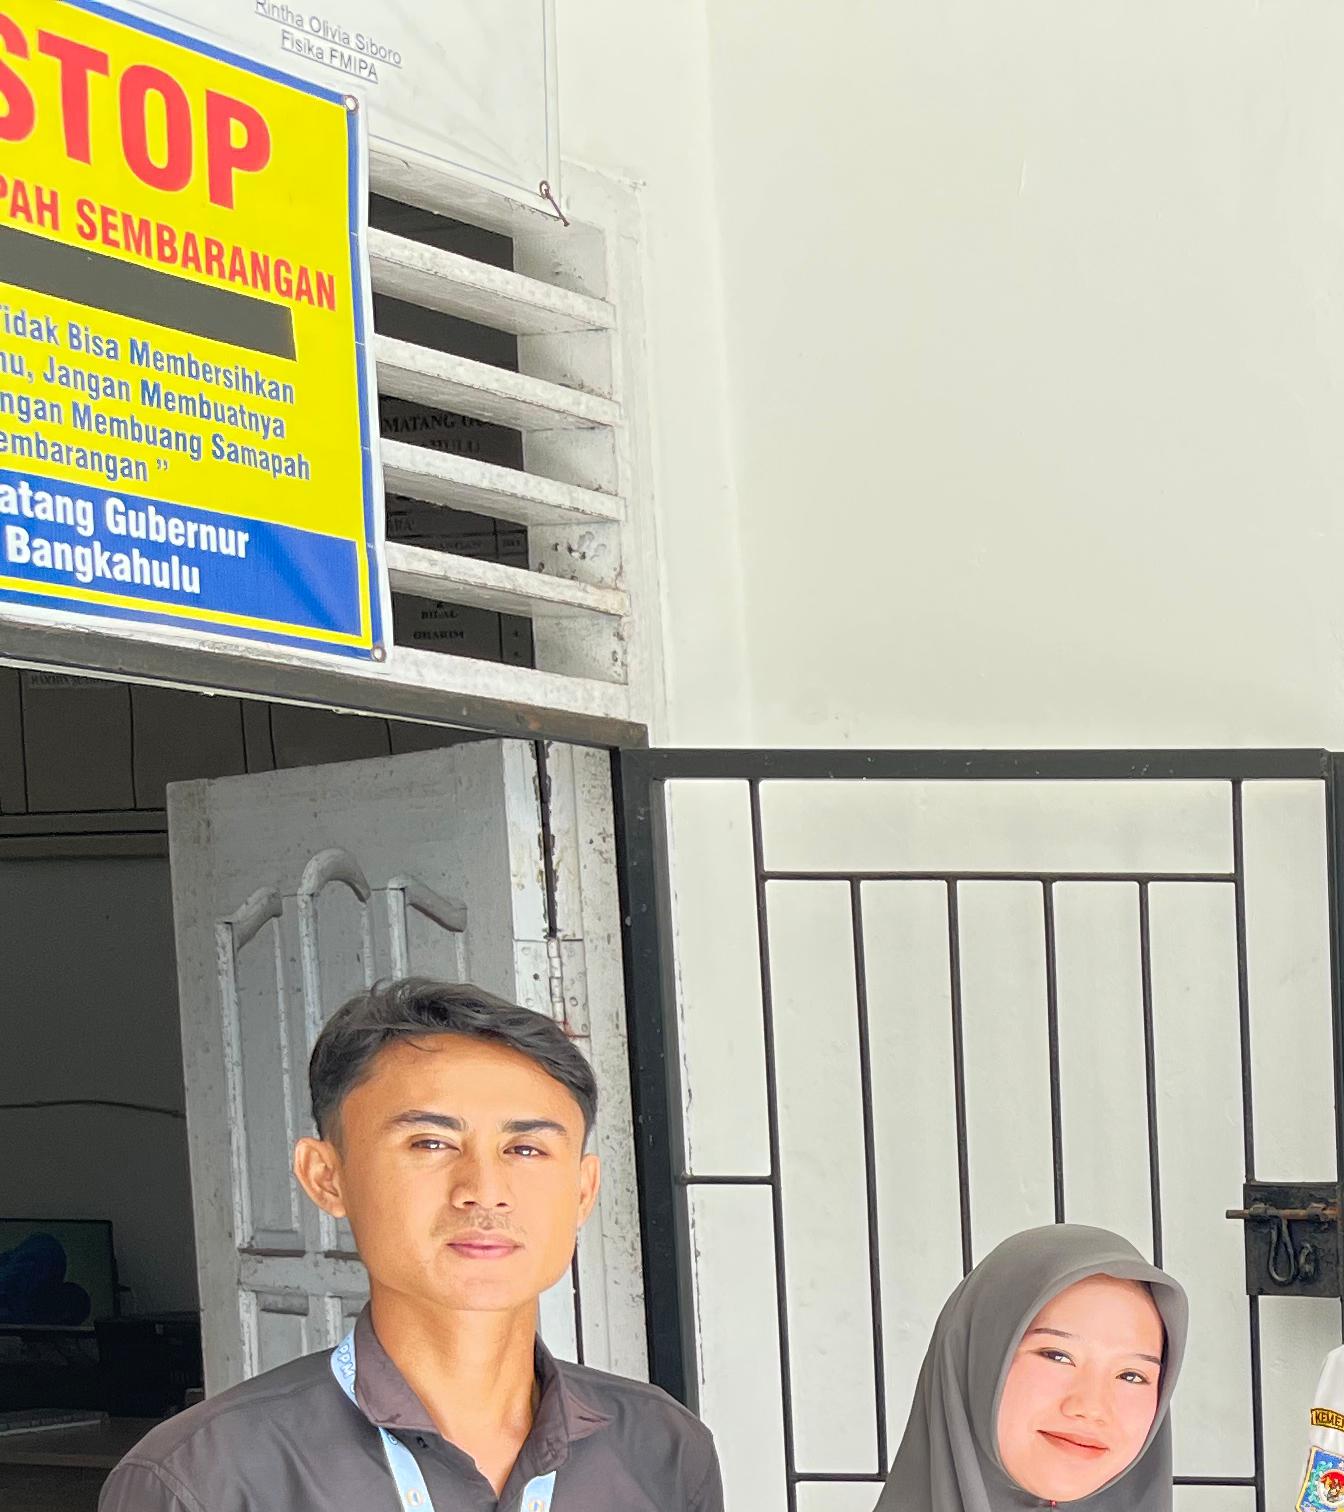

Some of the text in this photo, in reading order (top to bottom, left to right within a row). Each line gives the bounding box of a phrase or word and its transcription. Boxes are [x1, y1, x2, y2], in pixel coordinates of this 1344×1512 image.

[256, 0, 402, 64] Rintha Olivia Siboro
[281, 29, 378, 79] Fisika FMIPA
[76, 198, 336, 311] SEMBARANGAN
[0, 305, 295, 404] idak Bisa Membersihkan
[43, 356, 131, 402] Jangan
[140, 379, 286, 440] Membuatnya
[72, 401, 202, 461] Membuang
[211, 433, 311, 480] Samapah
[4, 524, 201, 594] Bangkahulu
[105, 497, 250, 559] Gubernur
